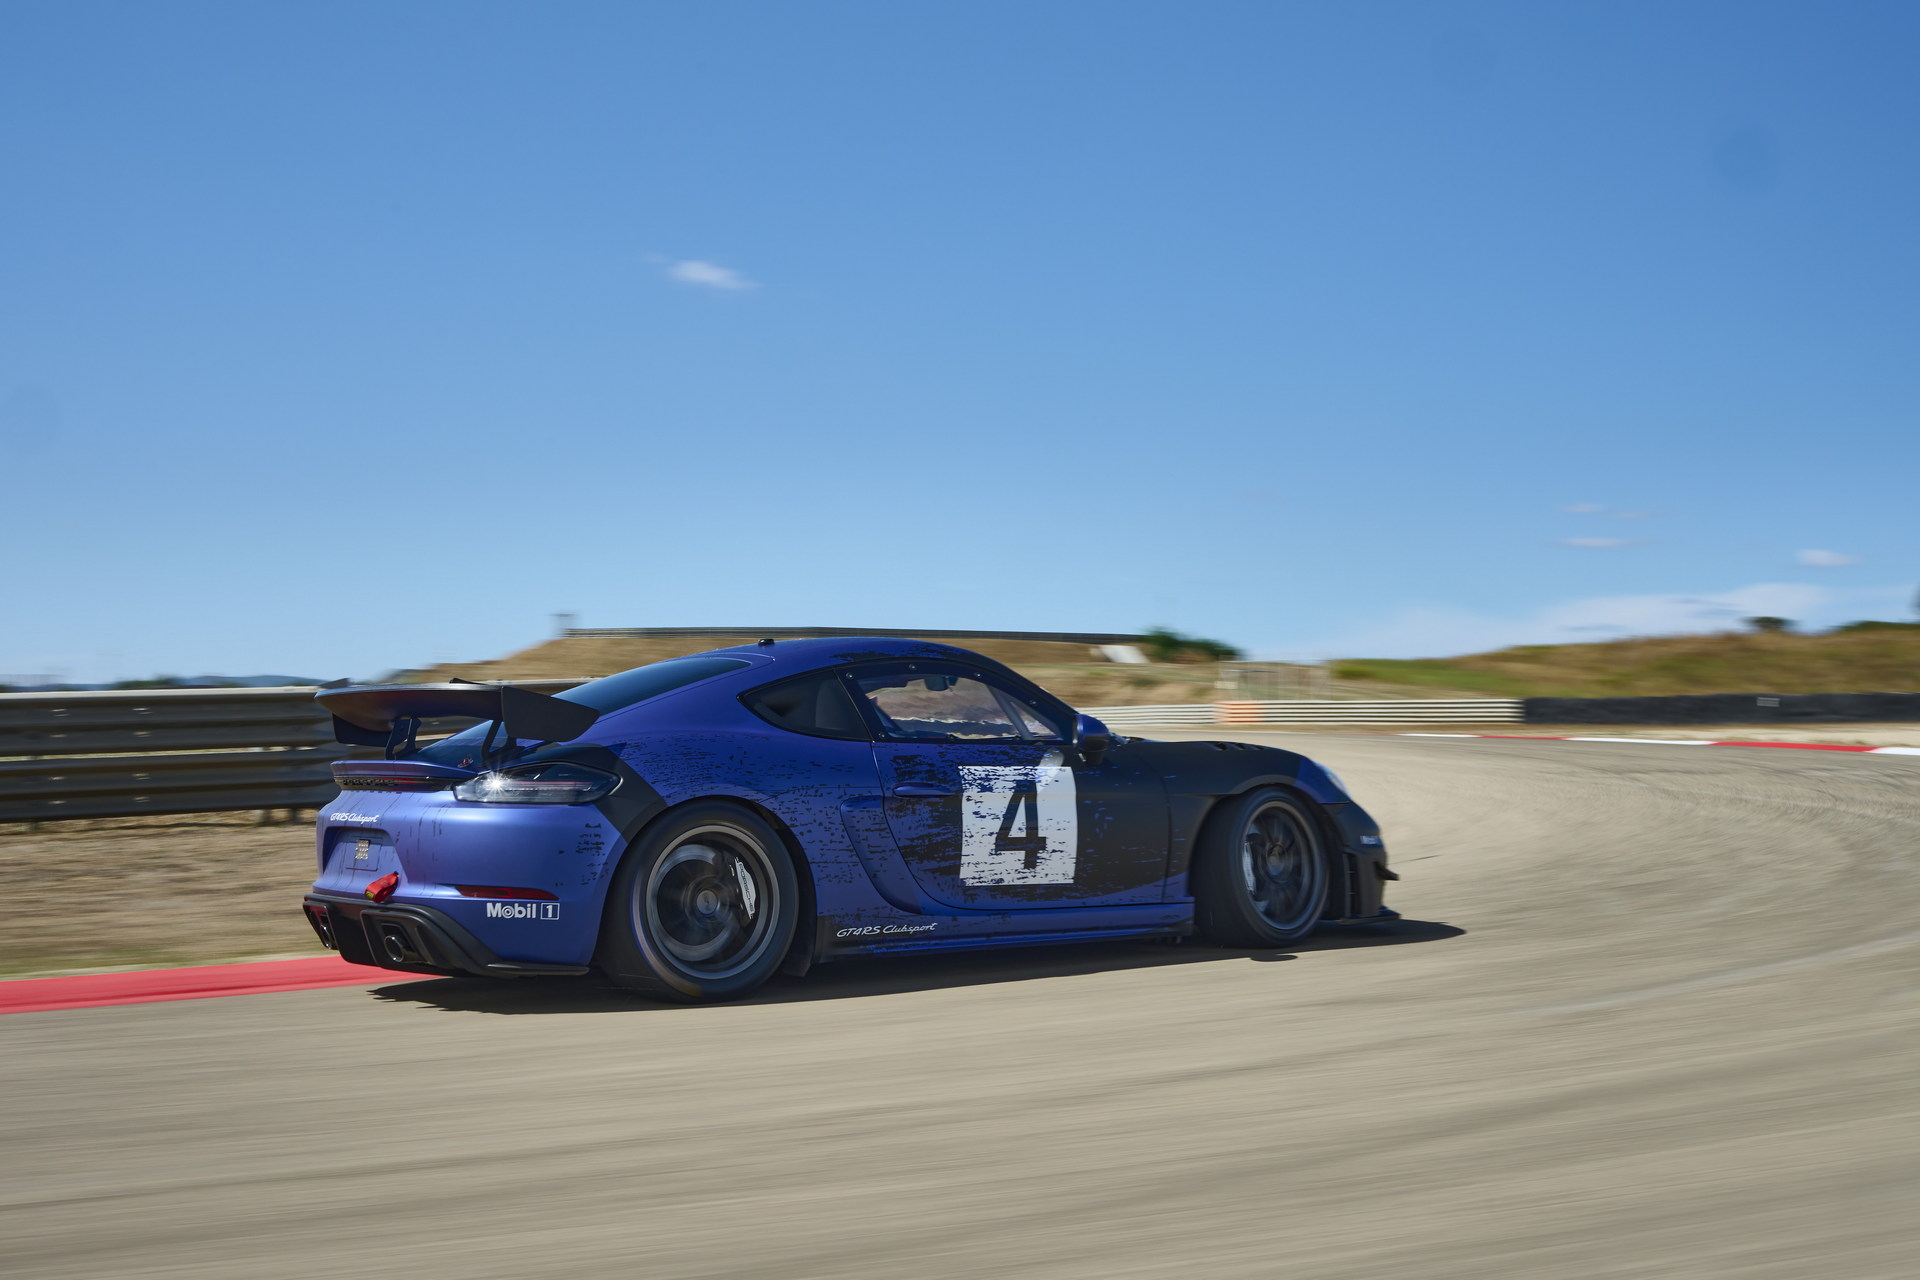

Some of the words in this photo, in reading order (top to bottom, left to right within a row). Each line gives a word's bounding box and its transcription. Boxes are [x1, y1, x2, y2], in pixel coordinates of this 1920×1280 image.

[994, 779, 1047, 870] 4
[739, 863, 755, 912] PORSCHE
[486, 902, 537, 919] Mobil
[882, 922, 938, 935] Clubsport
